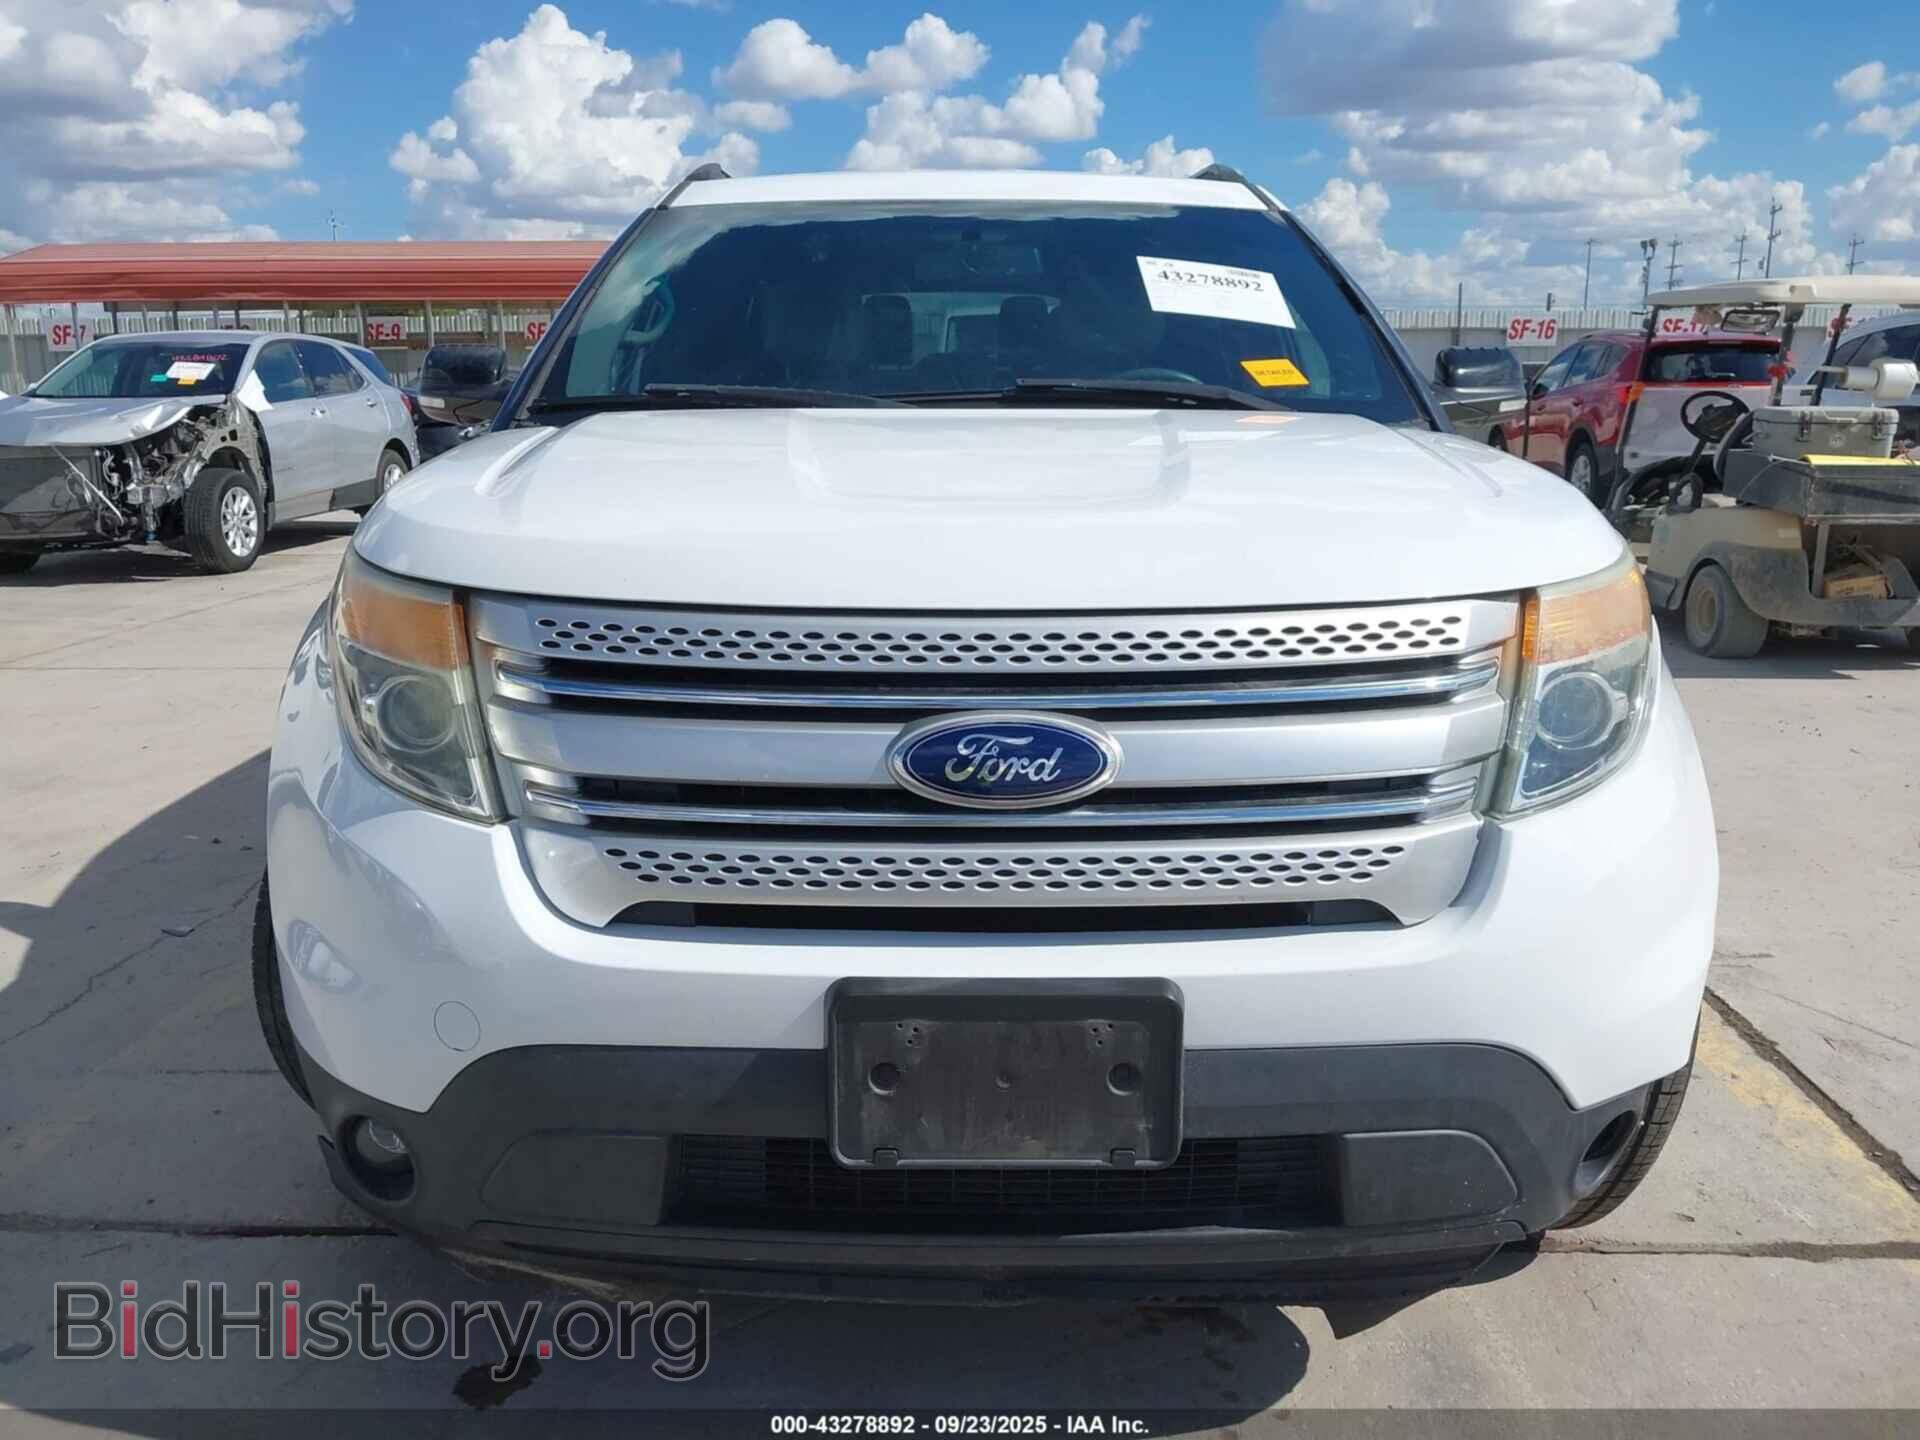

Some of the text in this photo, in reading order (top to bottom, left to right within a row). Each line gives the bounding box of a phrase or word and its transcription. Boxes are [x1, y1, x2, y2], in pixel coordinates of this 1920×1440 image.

[1156, 269, 1265, 293] 43278892
[52, 324, 86, 345] SF-7
[1508, 318, 1557, 341] SF-16
[944, 733, 1064, 782] Ford
